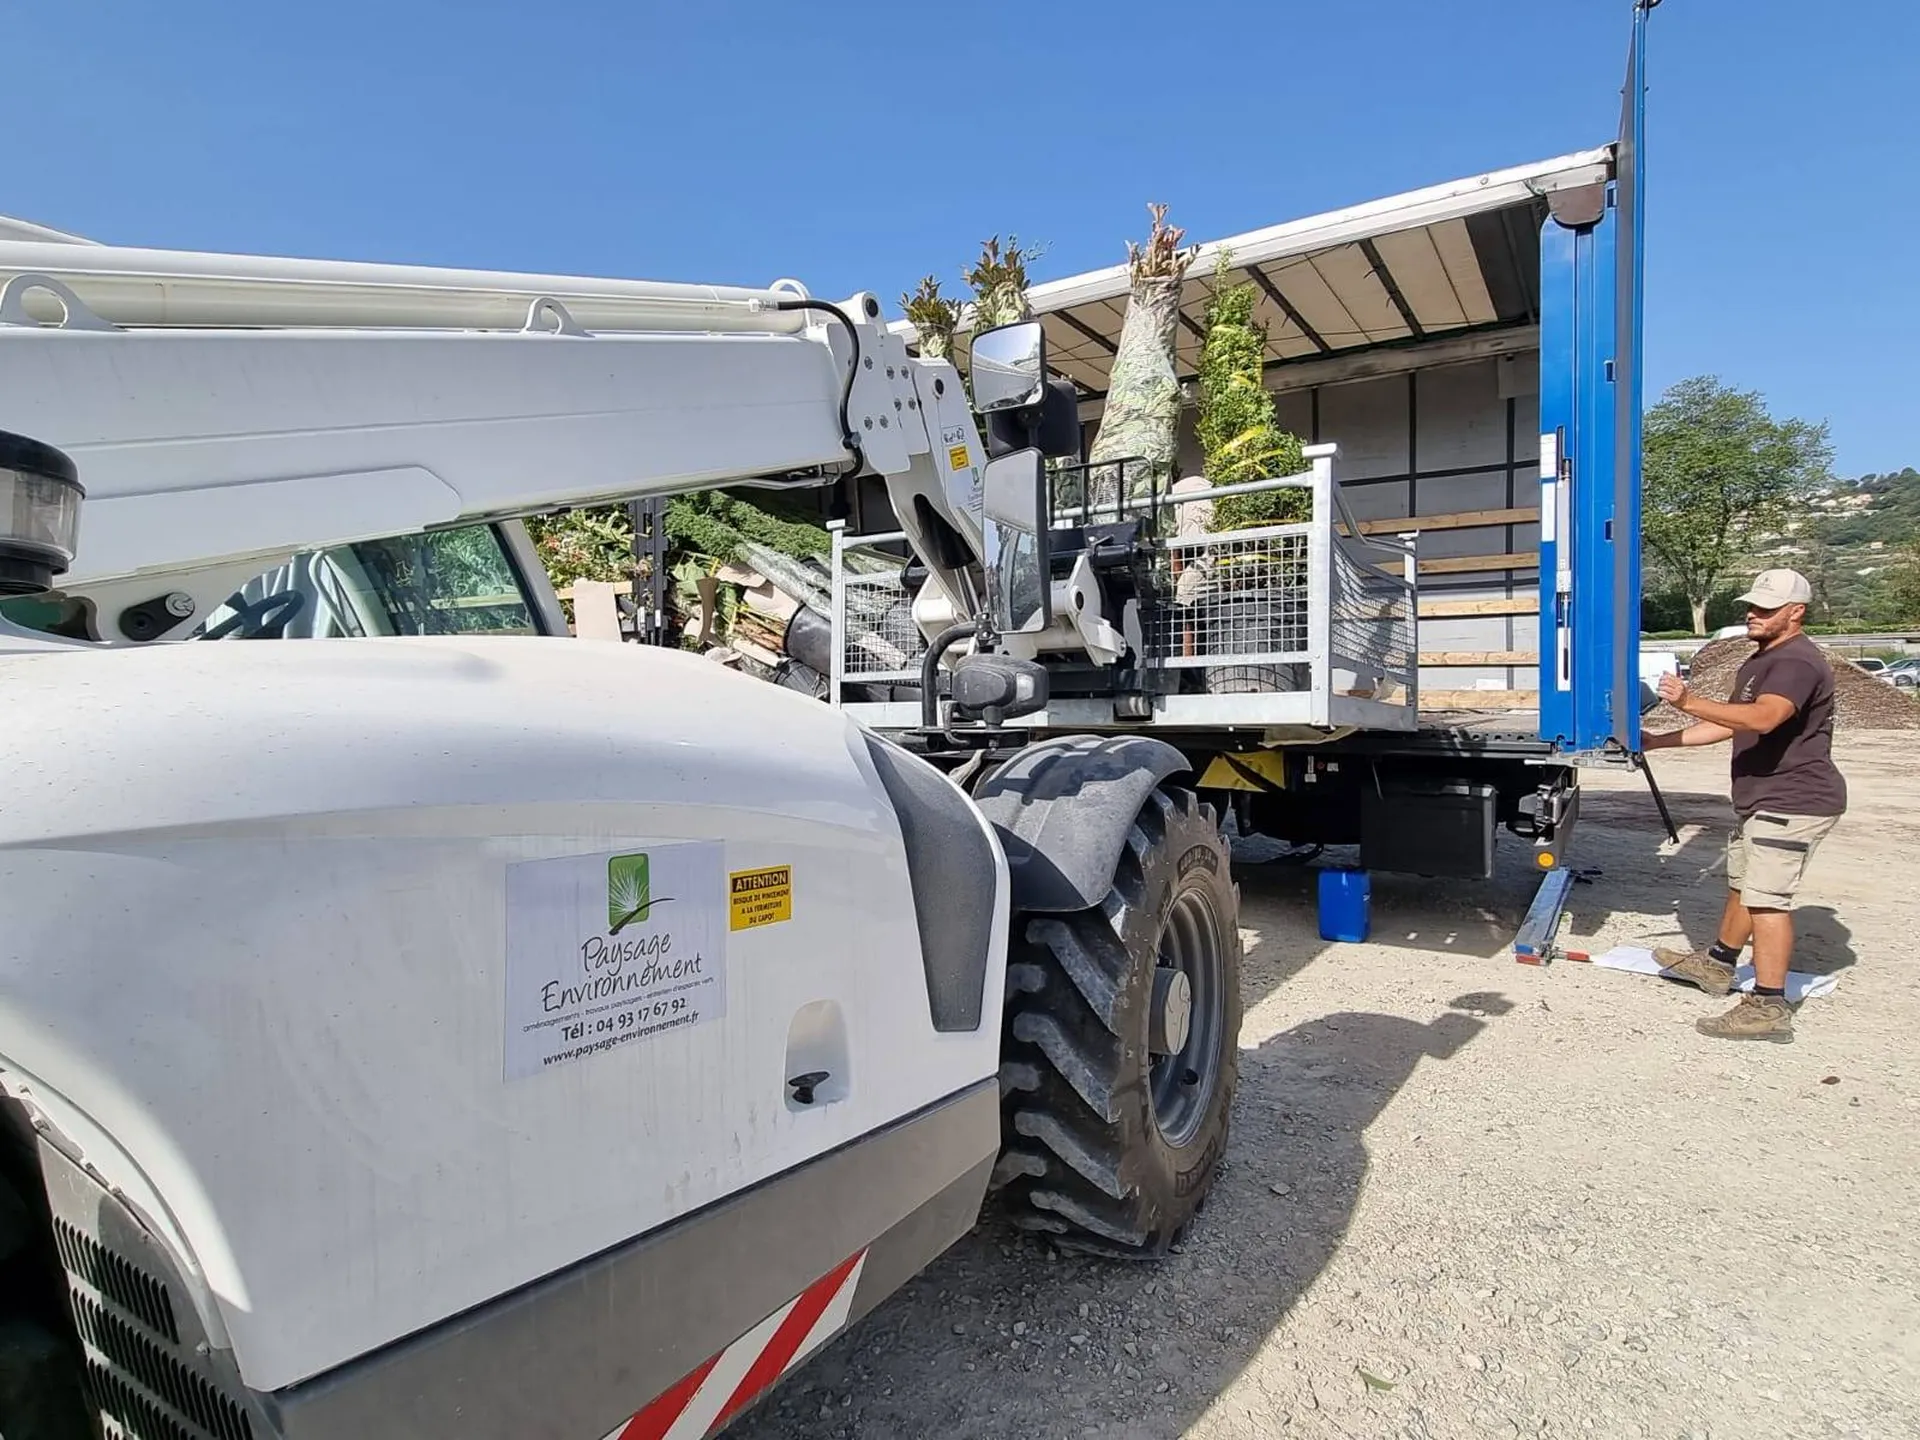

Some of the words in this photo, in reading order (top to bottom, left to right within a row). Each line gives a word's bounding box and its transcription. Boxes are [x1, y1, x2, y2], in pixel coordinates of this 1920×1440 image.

[735, 871, 787, 892] ATTENTION
[581, 933, 672, 976] Paysage
[541, 952, 702, 1012] Environnement
[543, 1010, 699, 1066] www.paysage-environnement.fr
[561, 1020, 584, 1042] Tél
[596, 1017, 614, 1033] 04
[618, 1012, 634, 1030] 93
[638, 1007, 650, 1022] 17
[653, 1002, 669, 1017] 67
[671, 997, 686, 1014] 92
